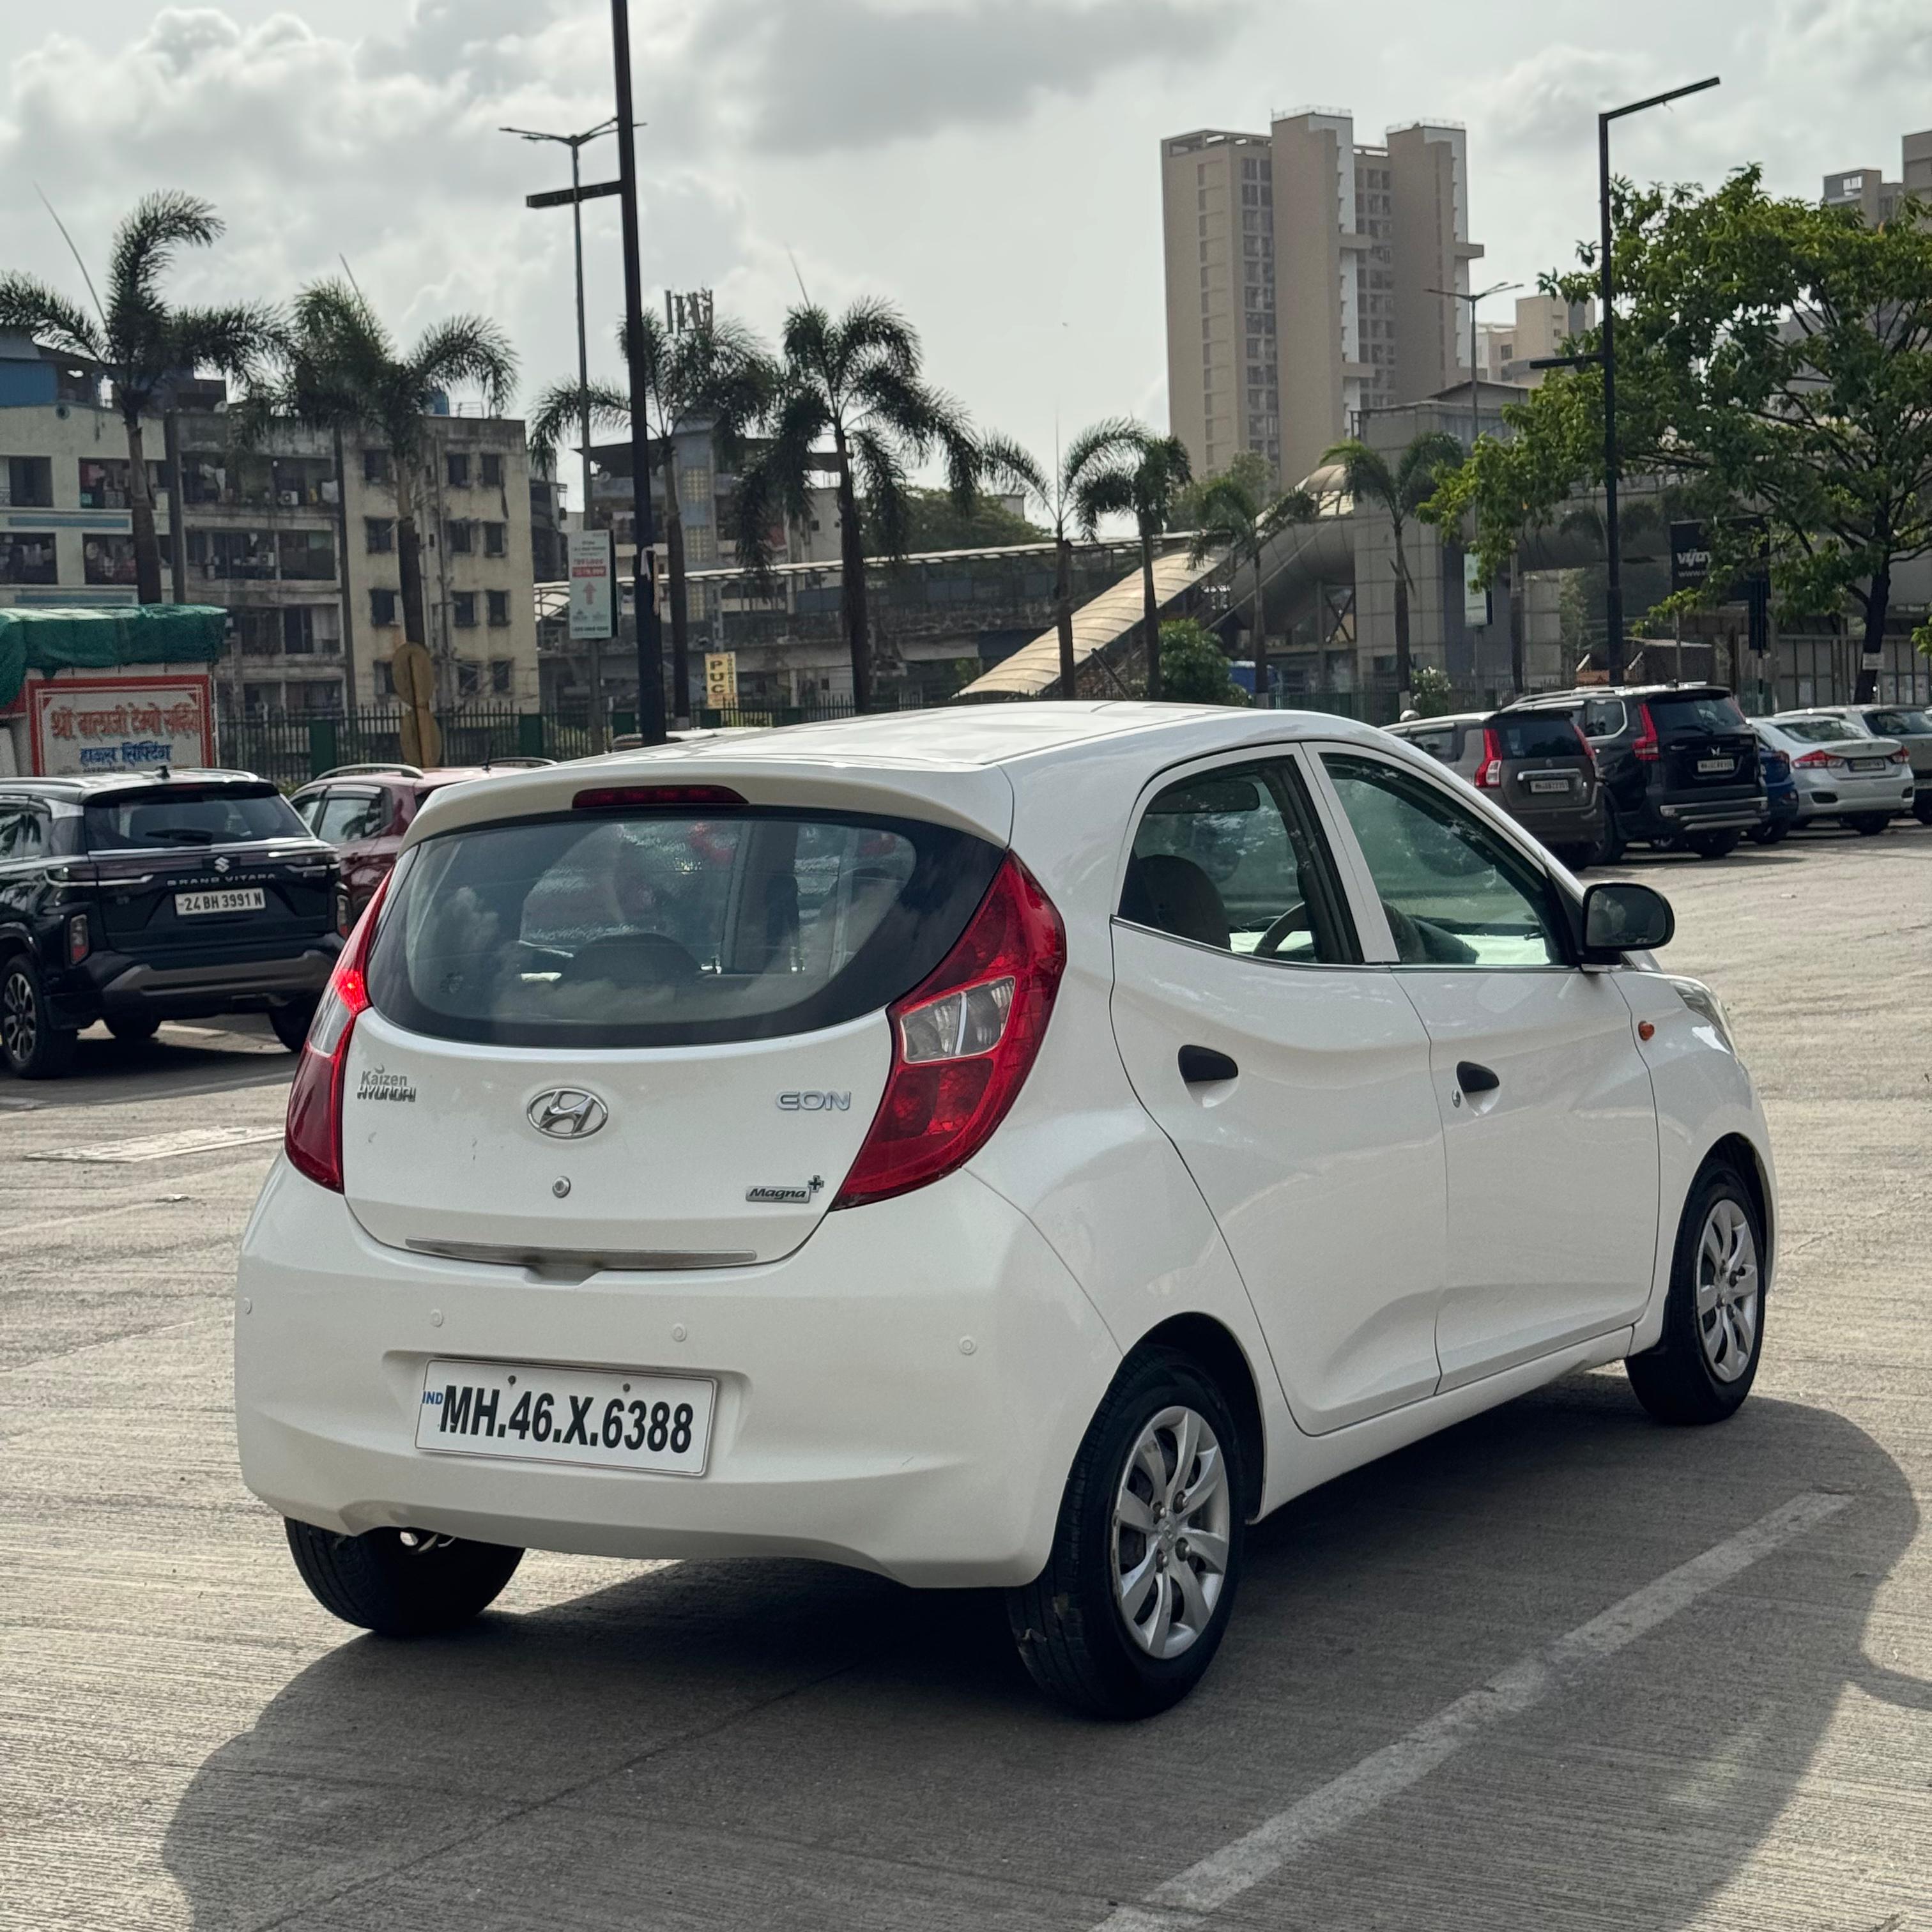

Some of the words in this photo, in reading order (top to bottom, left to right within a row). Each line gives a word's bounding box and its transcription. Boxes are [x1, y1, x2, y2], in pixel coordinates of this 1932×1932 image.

[710, 660, 725, 694] PUC
[167, 876, 220, 886] GRAND
[225, 873, 277, 882] VITARA
[360, 1066, 408, 1086] Kaizen
[356, 1085, 417, 1103] HYUNDAI
[776, 1091, 852, 1111] EON
[422, 1391, 443, 1406] IND
[440, 1384, 694, 1454] MH.46.X.6388
